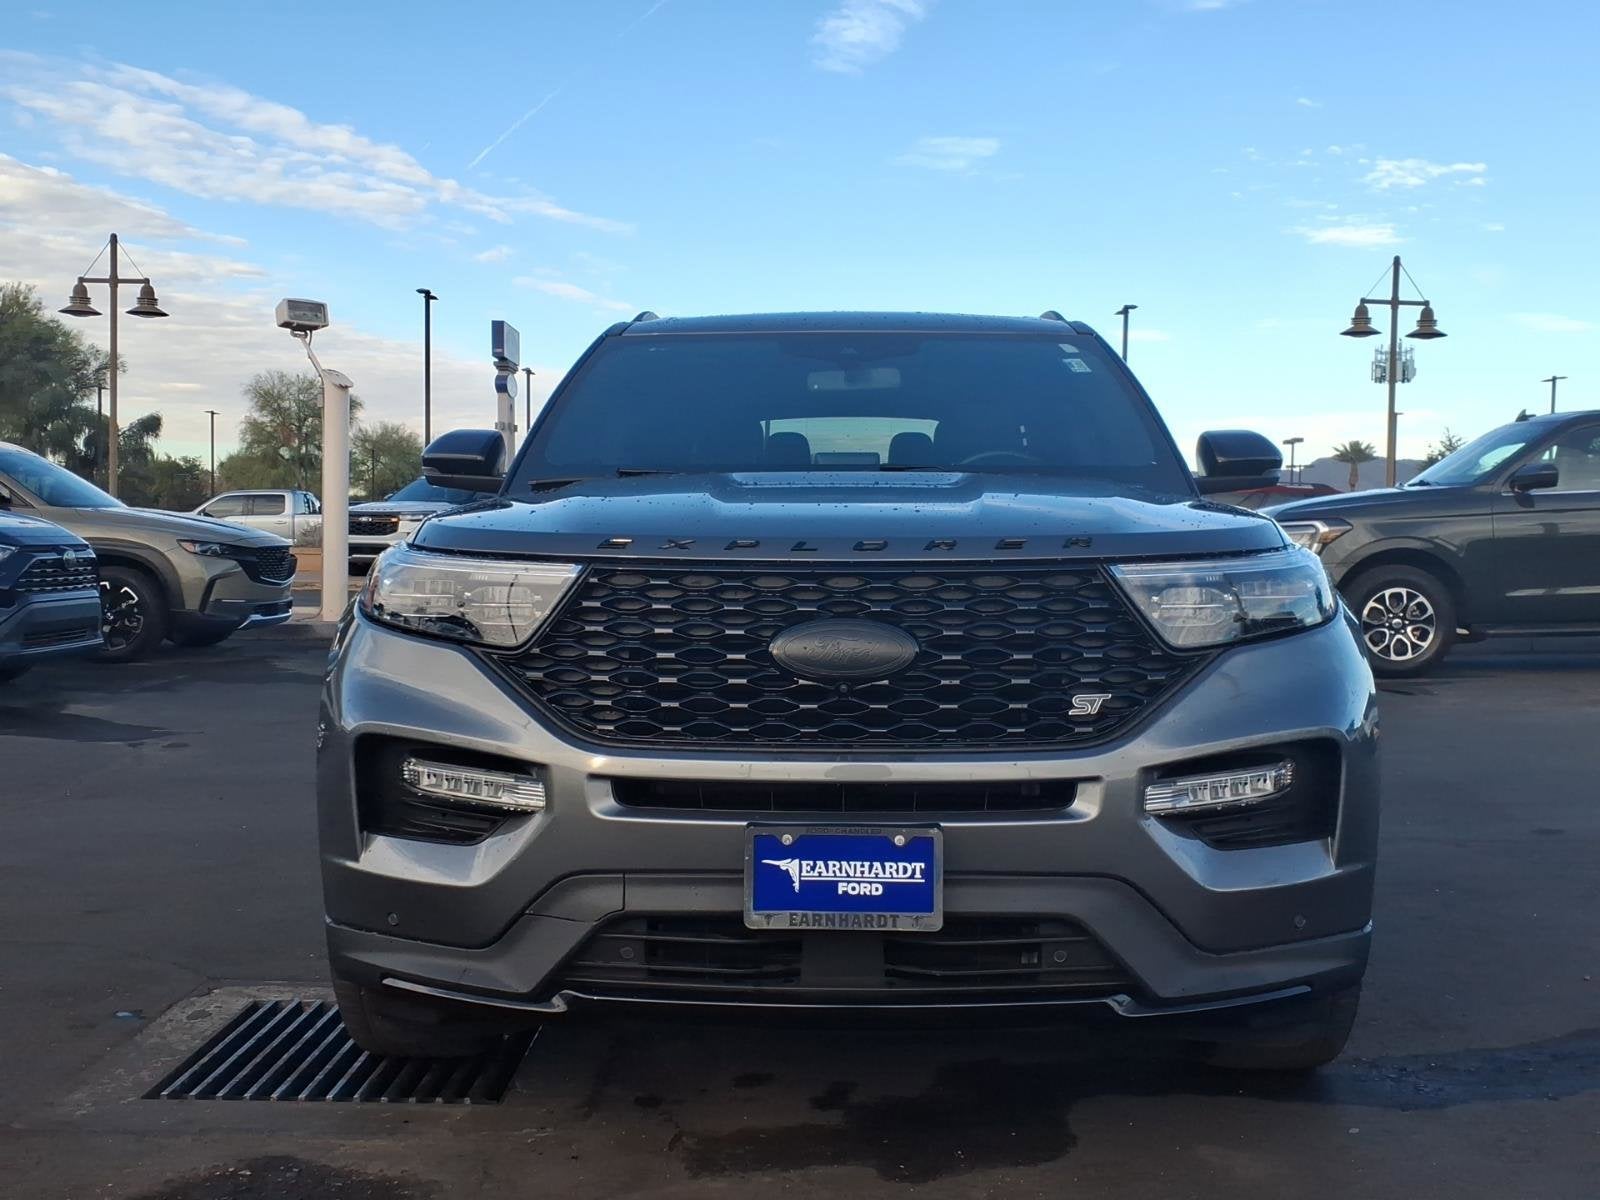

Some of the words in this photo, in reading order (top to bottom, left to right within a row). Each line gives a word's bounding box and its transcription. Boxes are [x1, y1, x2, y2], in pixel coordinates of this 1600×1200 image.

[597, 537, 1093, 551] EXPLORER
[1069, 693, 1112, 715] ST
[801, 860, 926, 878] EARNHARDT
[837, 882, 883, 896] FORD
[788, 912, 900, 928] EARNHARDT
